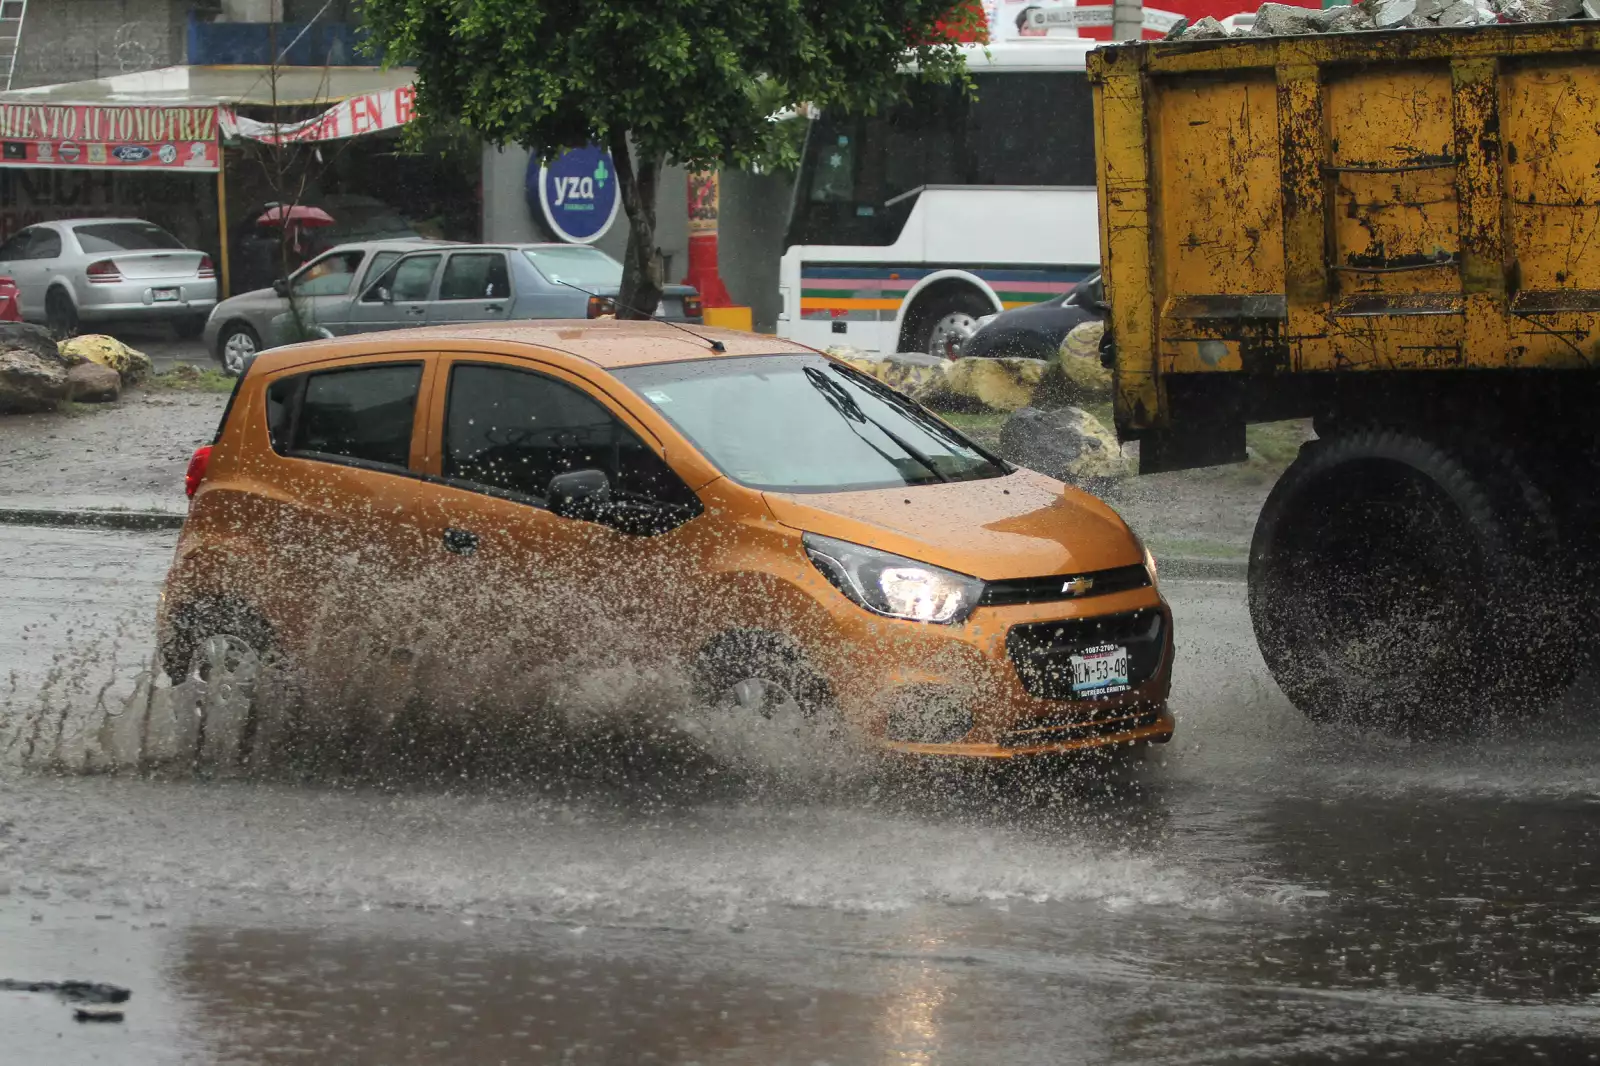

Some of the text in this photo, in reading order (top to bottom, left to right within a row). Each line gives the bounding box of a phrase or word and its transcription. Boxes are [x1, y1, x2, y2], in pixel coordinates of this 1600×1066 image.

[1047, 11, 1071, 22] ANILLO
[79, 106, 216, 141] AUTOMOTRIZ
[350, 92, 383, 134] EN
[120, 147, 144, 159] Ford
[554, 176, 595, 206] yza
[1087, 687, 1106, 696] TREBOL
